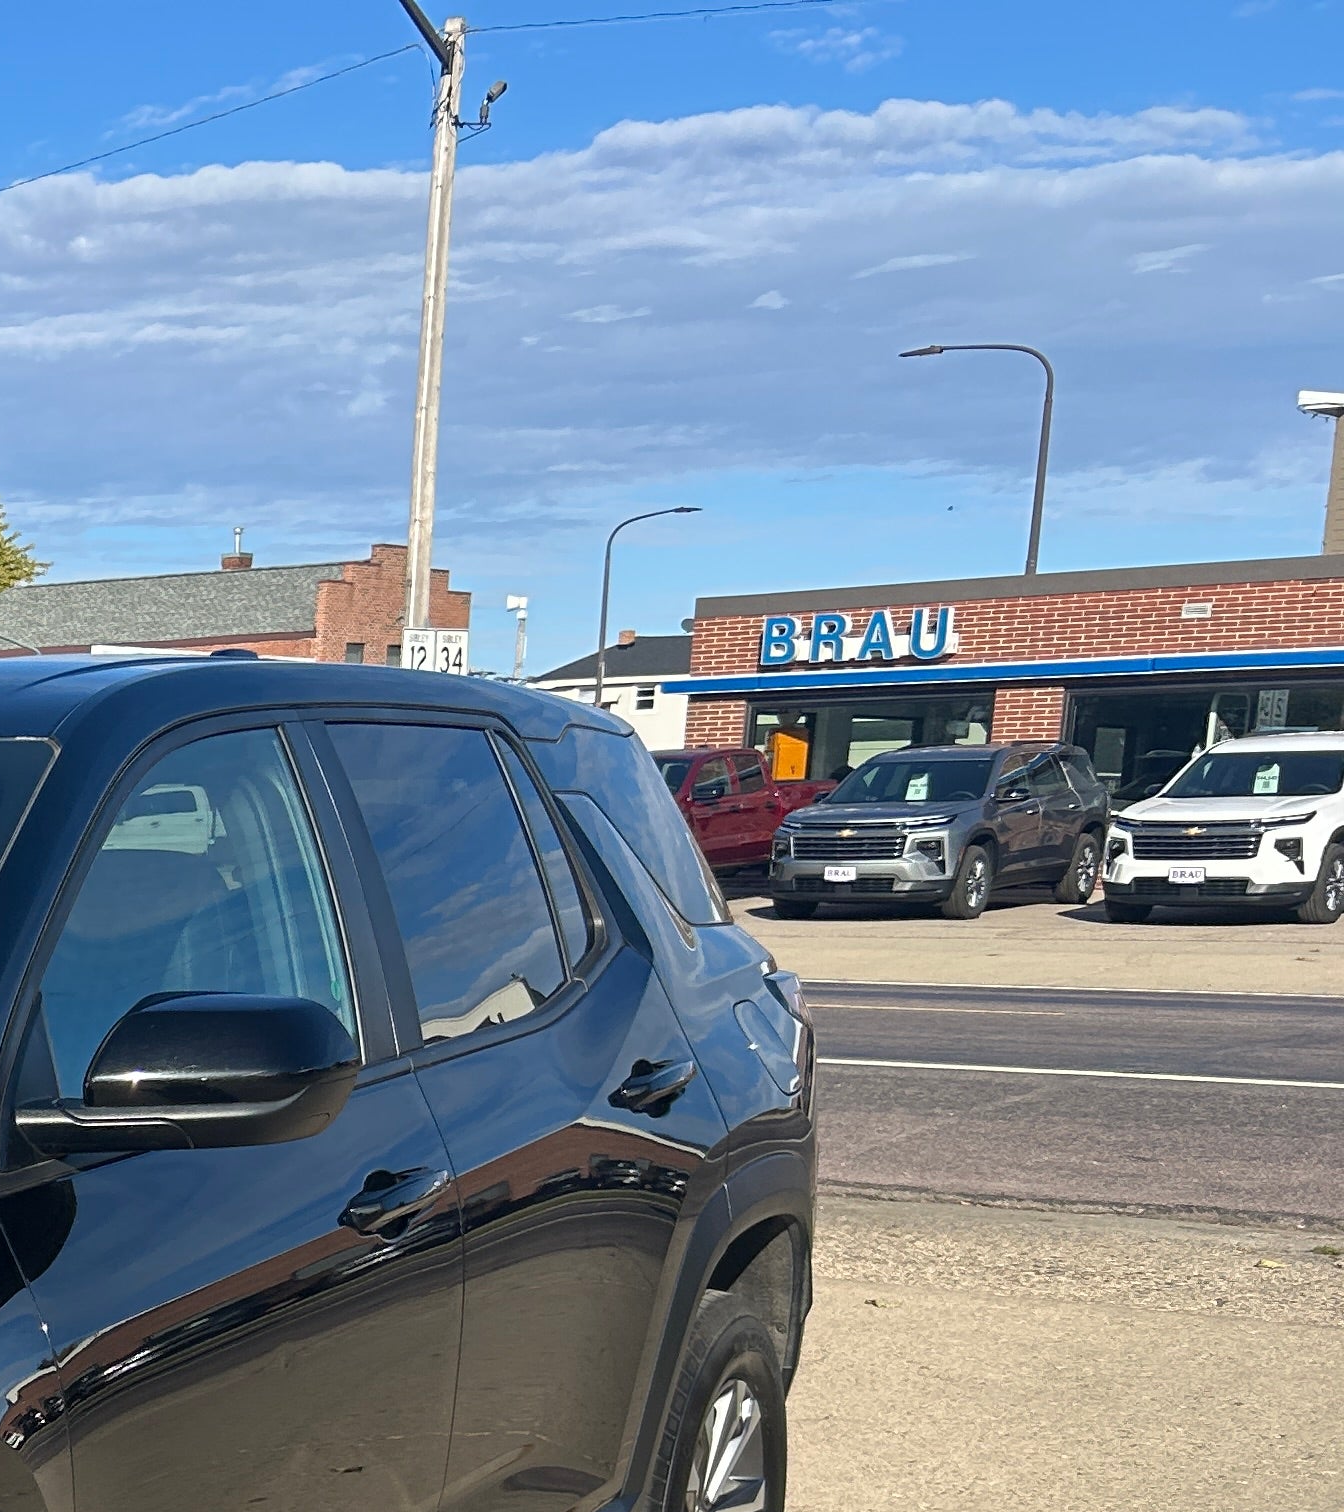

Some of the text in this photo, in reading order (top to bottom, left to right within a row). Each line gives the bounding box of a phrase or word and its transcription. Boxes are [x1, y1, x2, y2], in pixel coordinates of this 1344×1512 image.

[760, 607, 955, 665] BRAU
[411, 645, 427, 670] 12
[440, 646, 463, 675] 34
[1172, 870, 1203, 879] BRAU
